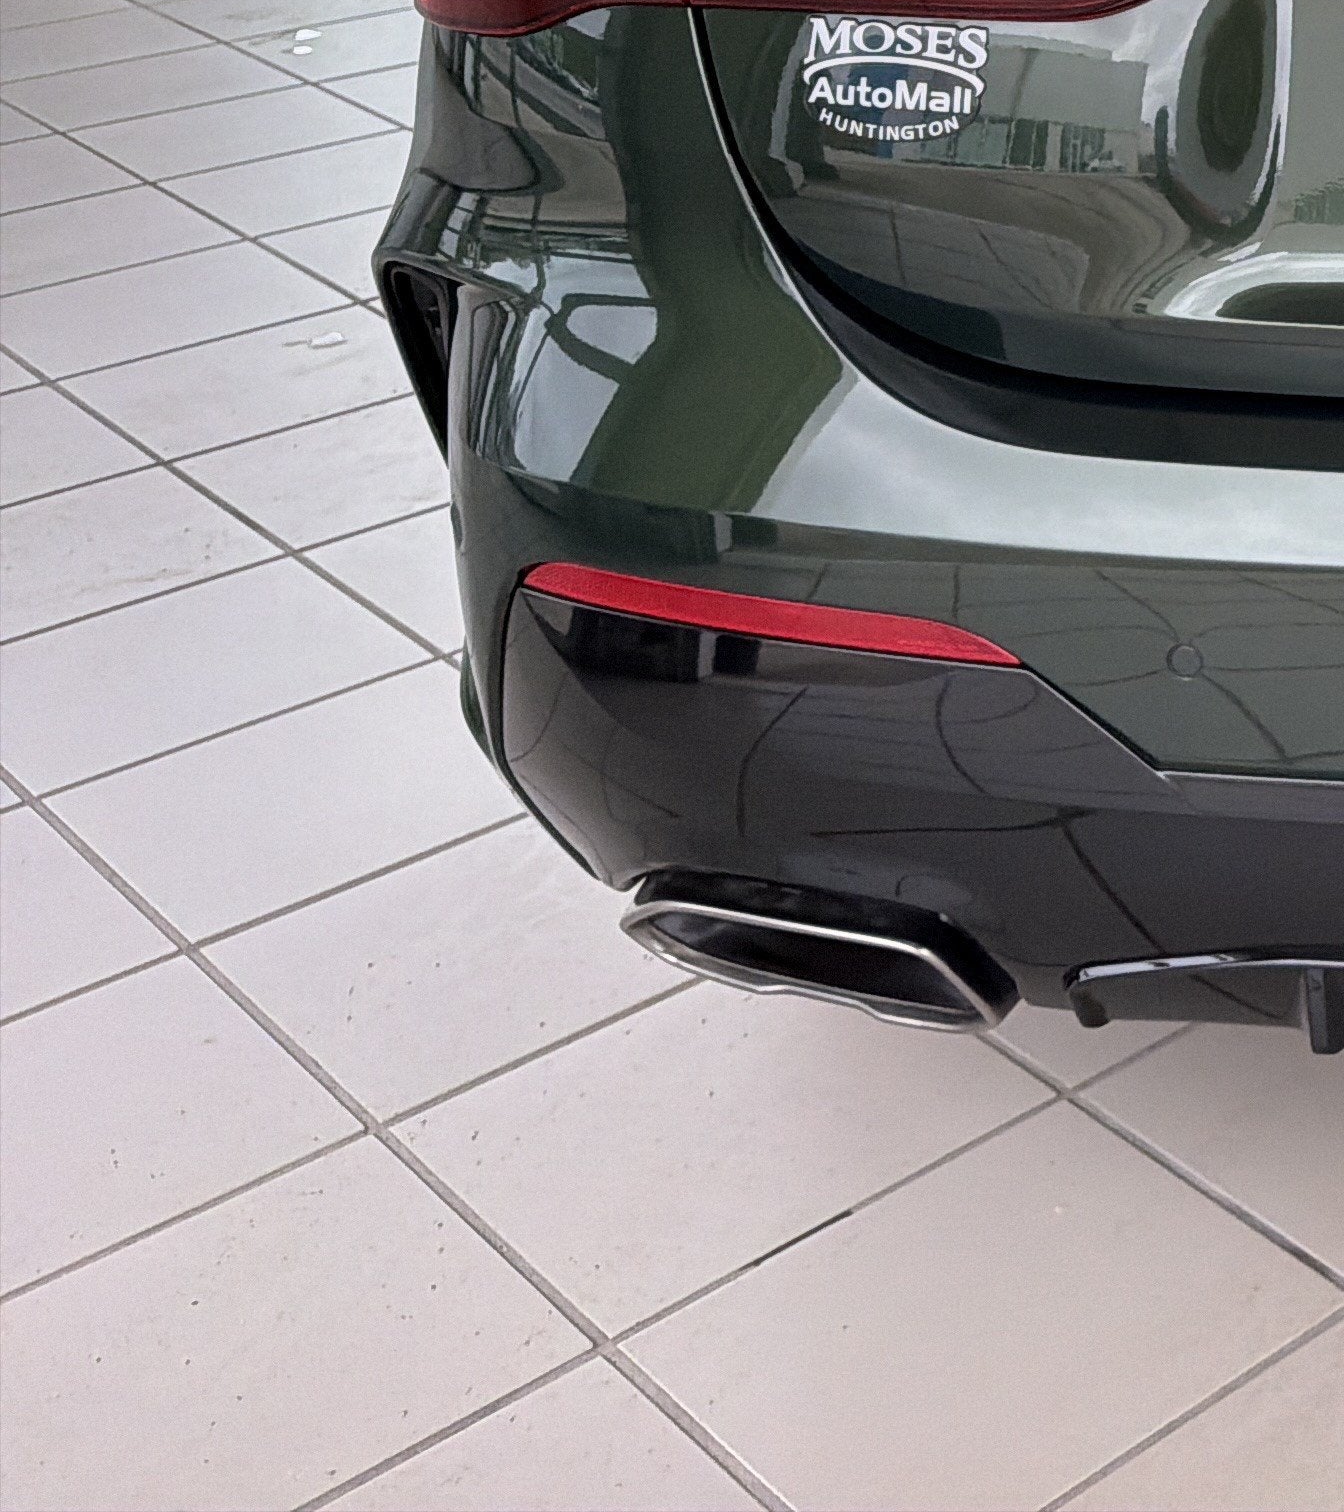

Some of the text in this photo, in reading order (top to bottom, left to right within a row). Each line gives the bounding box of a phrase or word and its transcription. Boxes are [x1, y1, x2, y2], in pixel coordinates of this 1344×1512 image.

[803, 17, 988, 69] MOSES
[808, 76, 973, 115] AutoMall
[819, 107, 960, 141] HUNTINGTON
